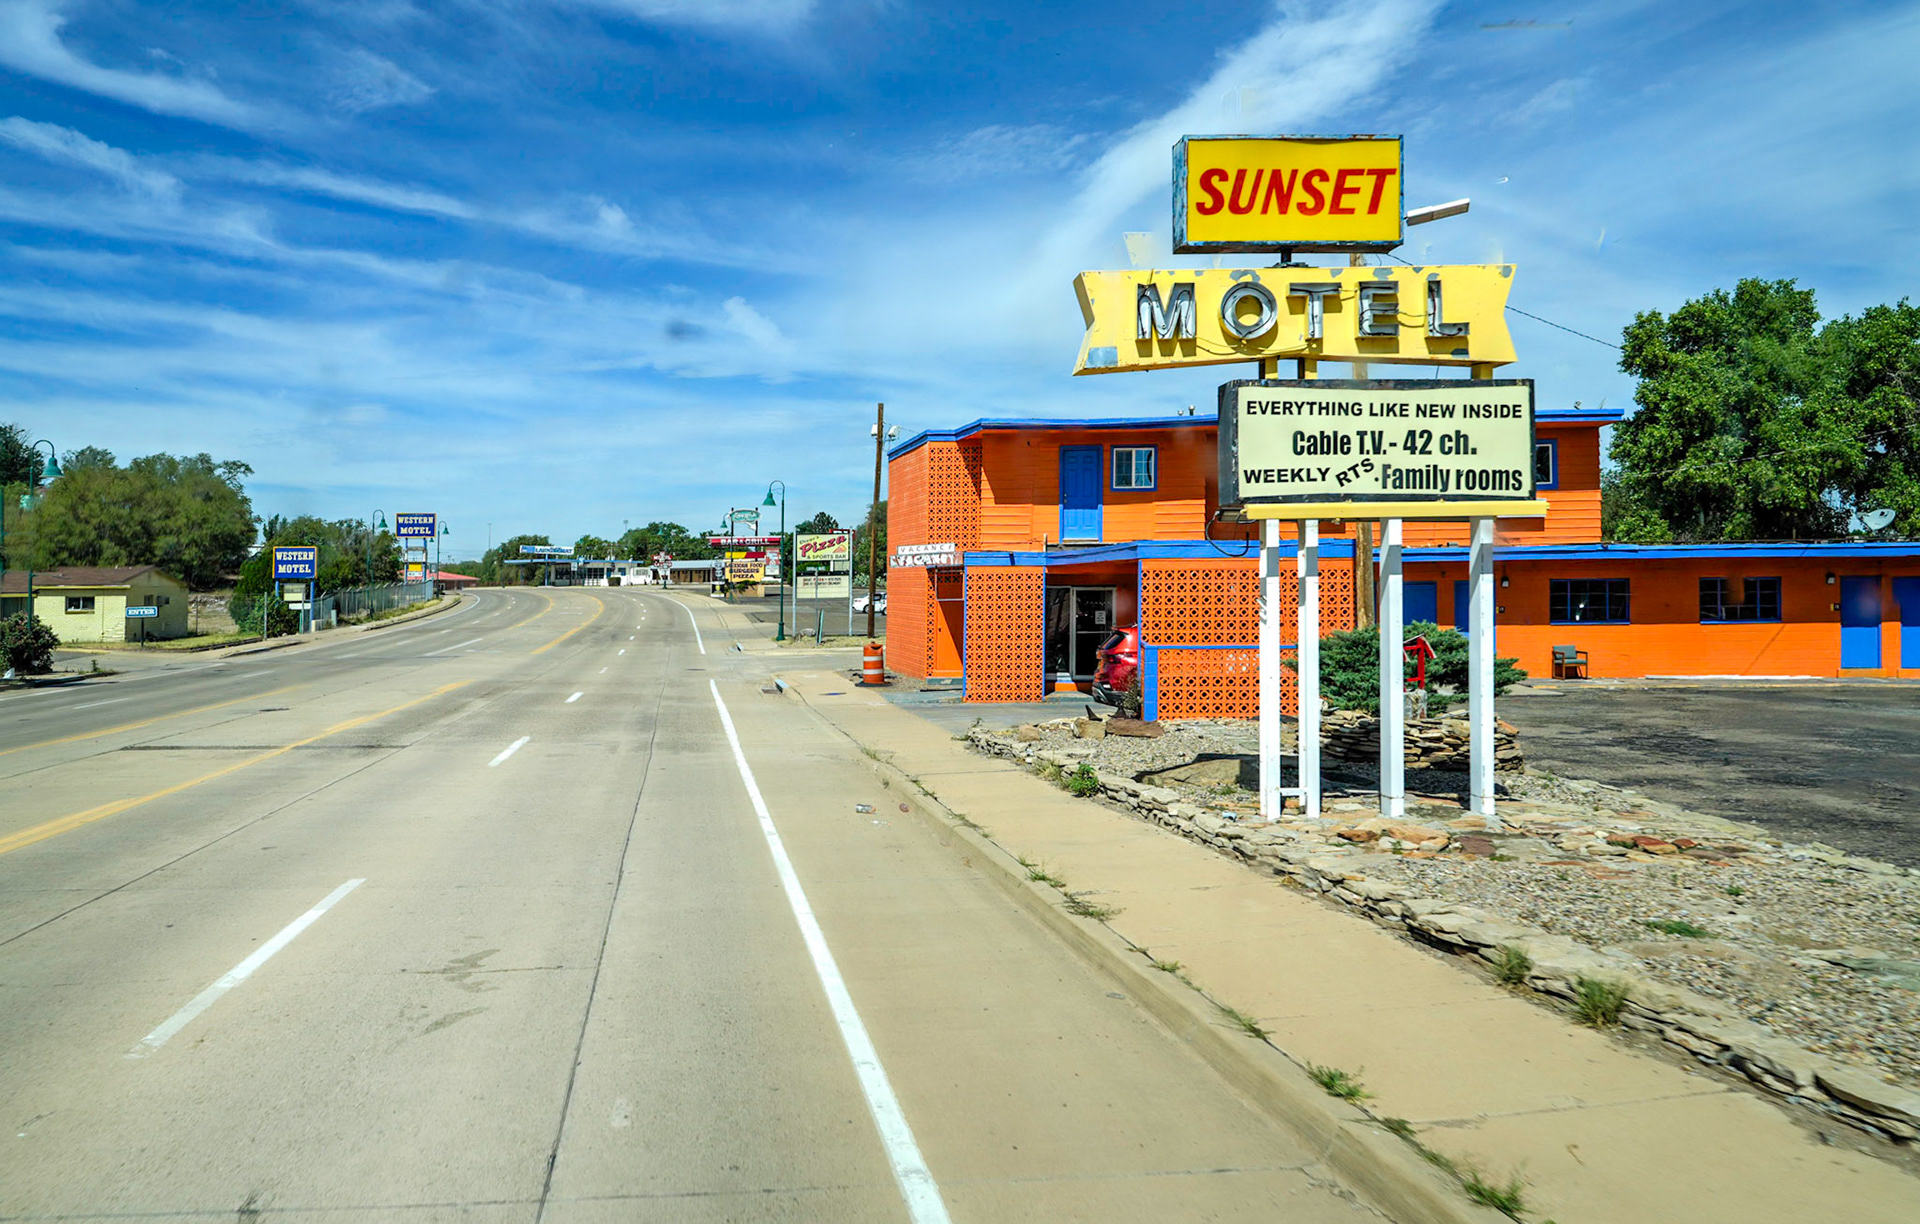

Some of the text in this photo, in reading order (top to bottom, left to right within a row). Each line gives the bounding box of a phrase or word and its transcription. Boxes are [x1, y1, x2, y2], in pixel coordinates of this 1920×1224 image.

[1195, 167, 1397, 216] SUNSET
[1135, 280, 1470, 341] MOTEL
[1246, 400, 1522, 419] EVERYTHING LIKE NEW INSIDE
[1292, 430, 1351, 456] Cable
[1403, 429, 1432, 456] 42
[1439, 430, 1477, 456] ch.
[1243, 467, 1331, 484] WEEKLY
[1381, 464, 1450, 493] Family
[1456, 468, 1522, 491] rooms
[398, 516, 434, 524] WESTERN
[400, 526, 431, 535] MOTEL
[275, 551, 314, 561] WESTERN
[799, 535, 847, 557] Pizza
[278, 564, 312, 573] MOTEL
